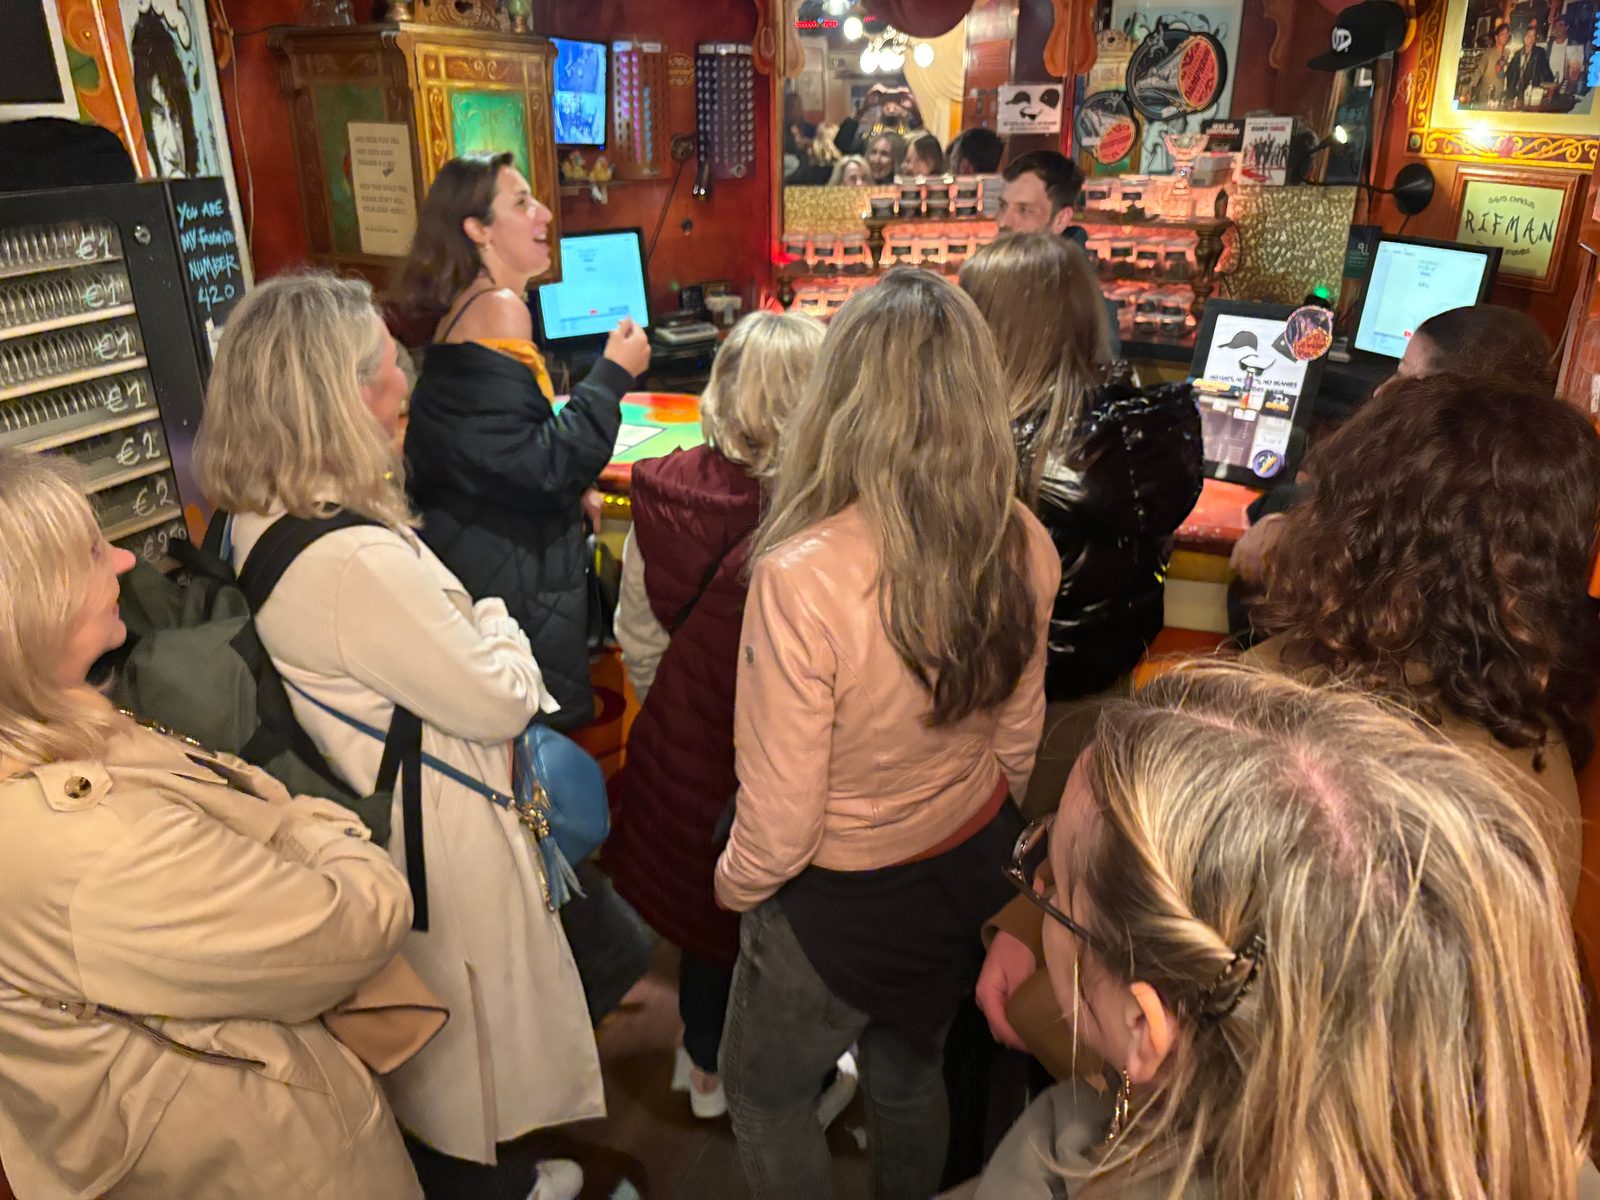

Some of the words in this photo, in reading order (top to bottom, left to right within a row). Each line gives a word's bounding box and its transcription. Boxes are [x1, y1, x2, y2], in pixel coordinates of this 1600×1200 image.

[1465, 208, 1554, 245] RIFMAN
[76, 234, 113, 260] €1
[188, 252, 240, 284] NUMBER
[82, 278, 120, 308] €1
[198, 284, 235, 312] 420
[94, 328, 137, 360] €1
[104, 380, 147, 413] €1
[116, 431, 160, 465] €2
[132, 477, 174, 516] €2
